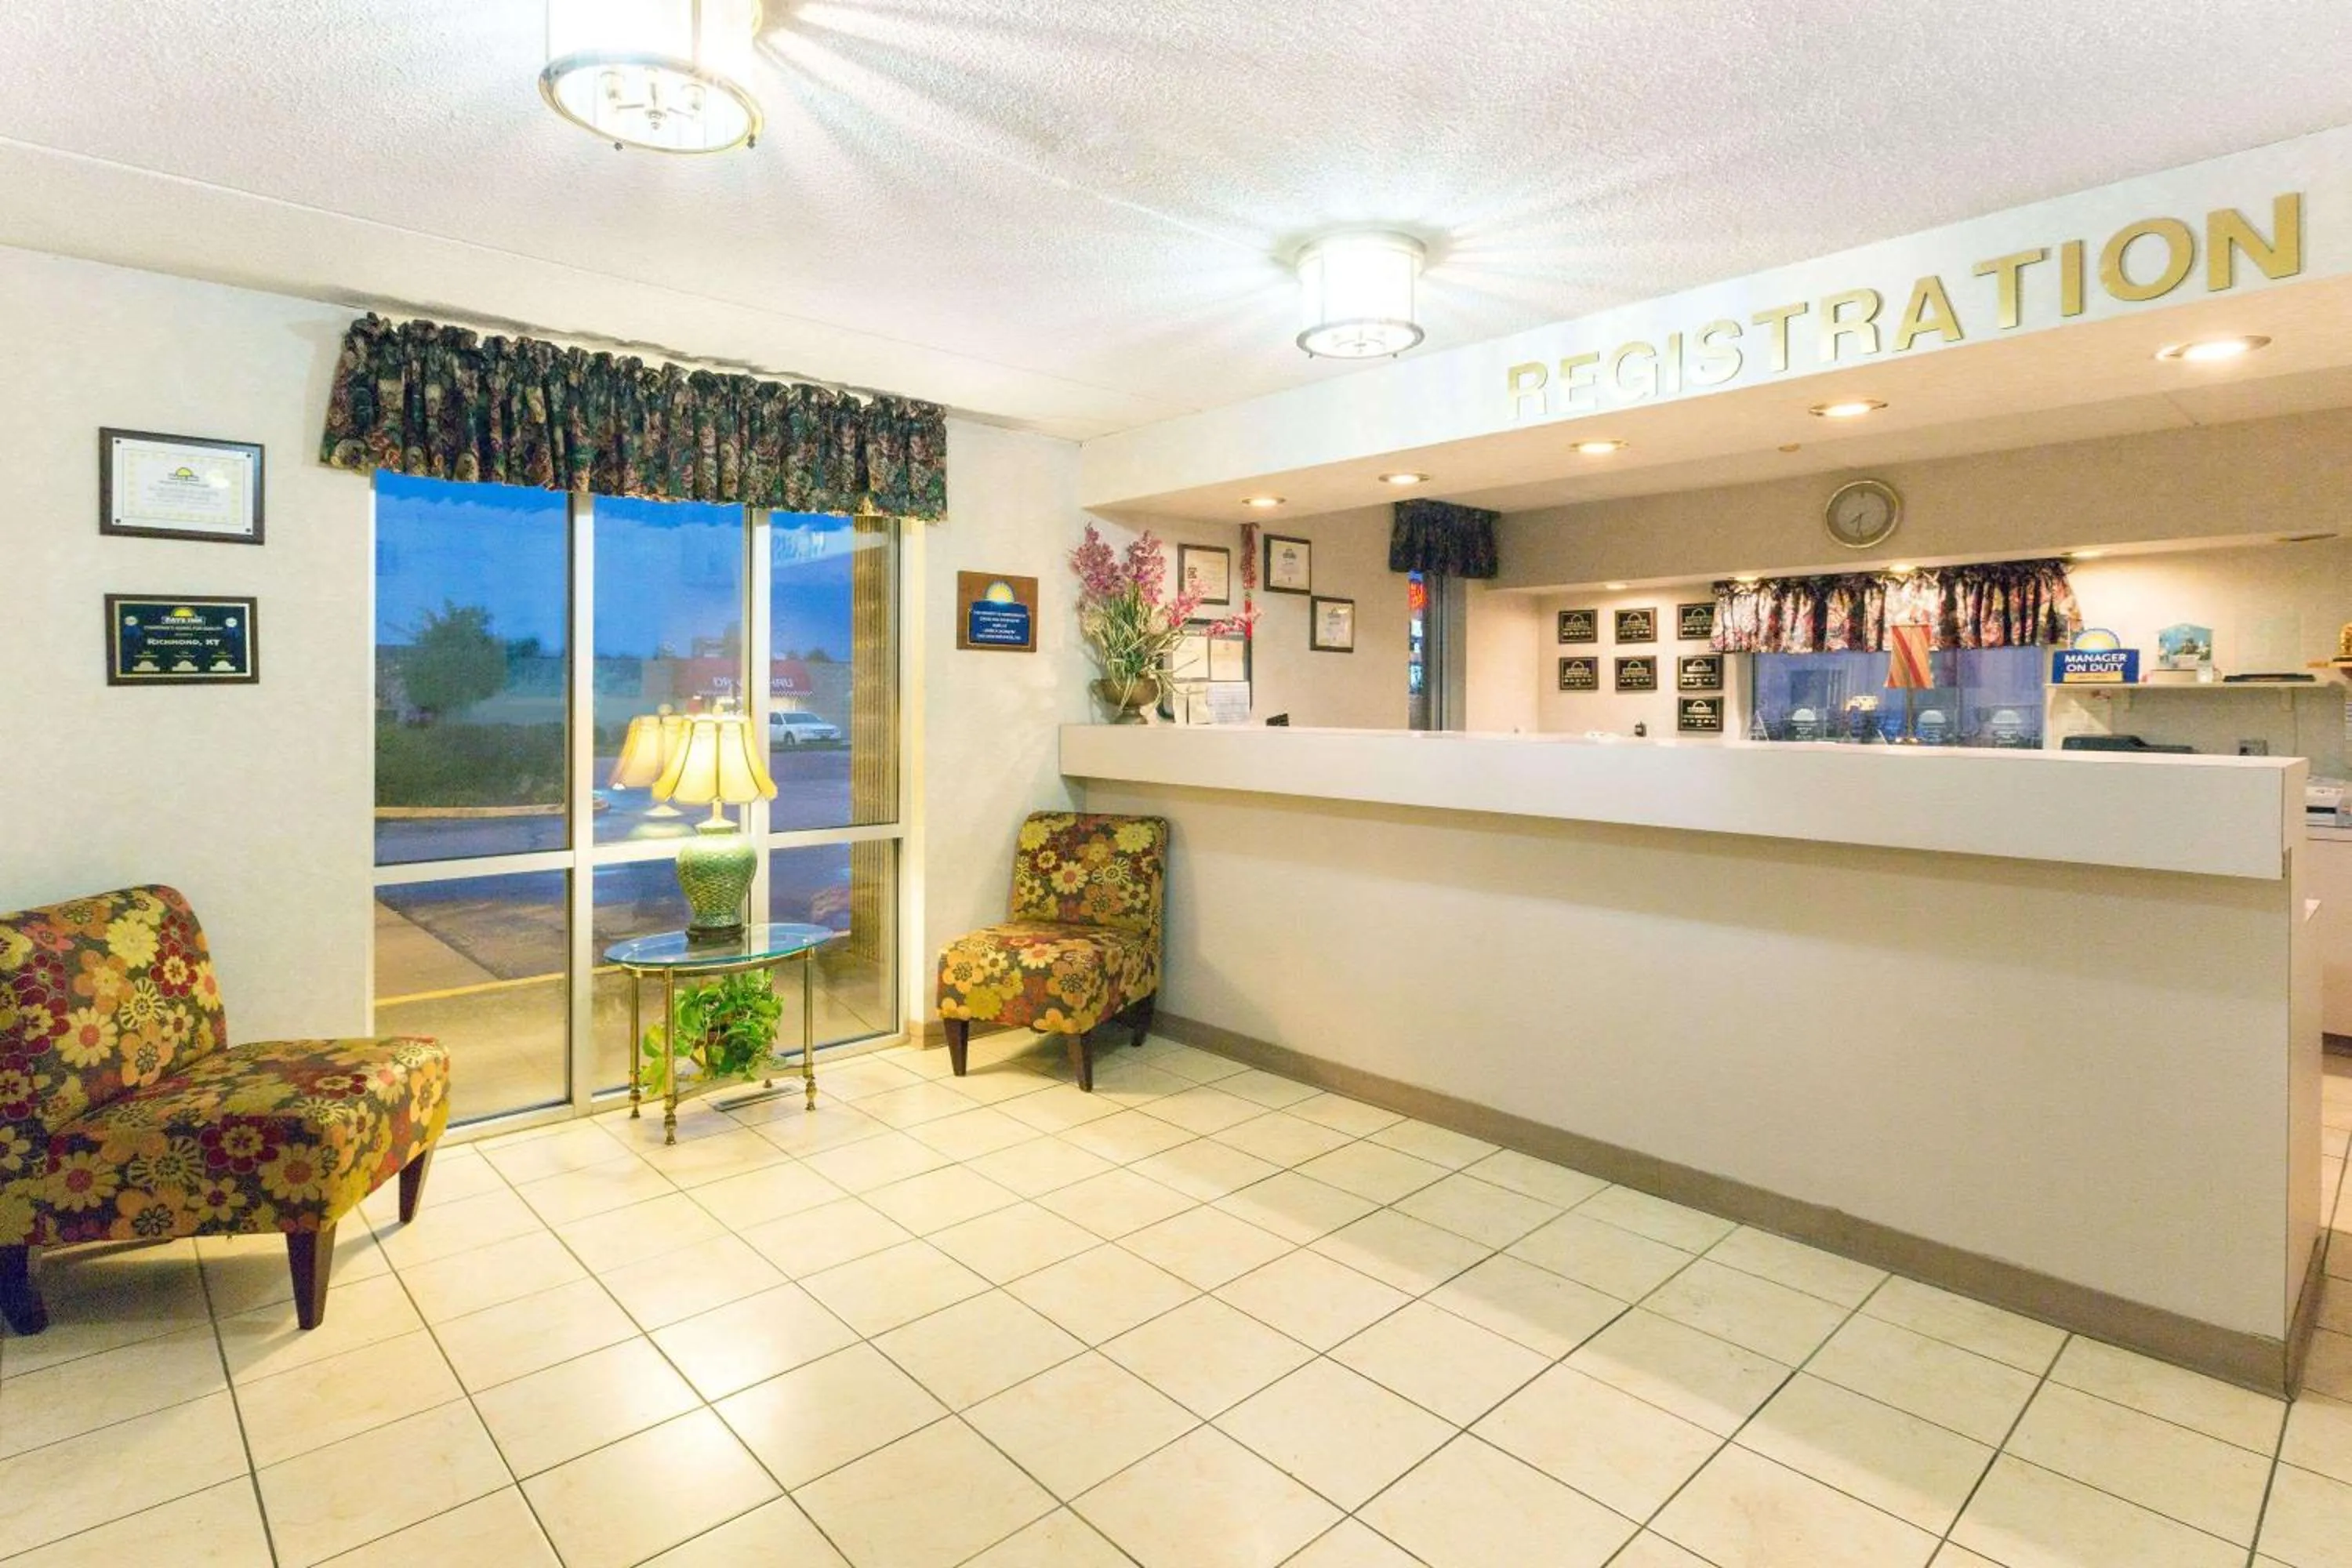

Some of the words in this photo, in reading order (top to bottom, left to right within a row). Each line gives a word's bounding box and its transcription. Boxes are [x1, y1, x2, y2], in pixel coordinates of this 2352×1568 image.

[1505, 192, 2305, 422] REGISTRATION
[2064, 653, 2127, 662] MANAGER
[2066, 663, 2085, 672] ON
[2089, 663, 2124, 672] DUTY
